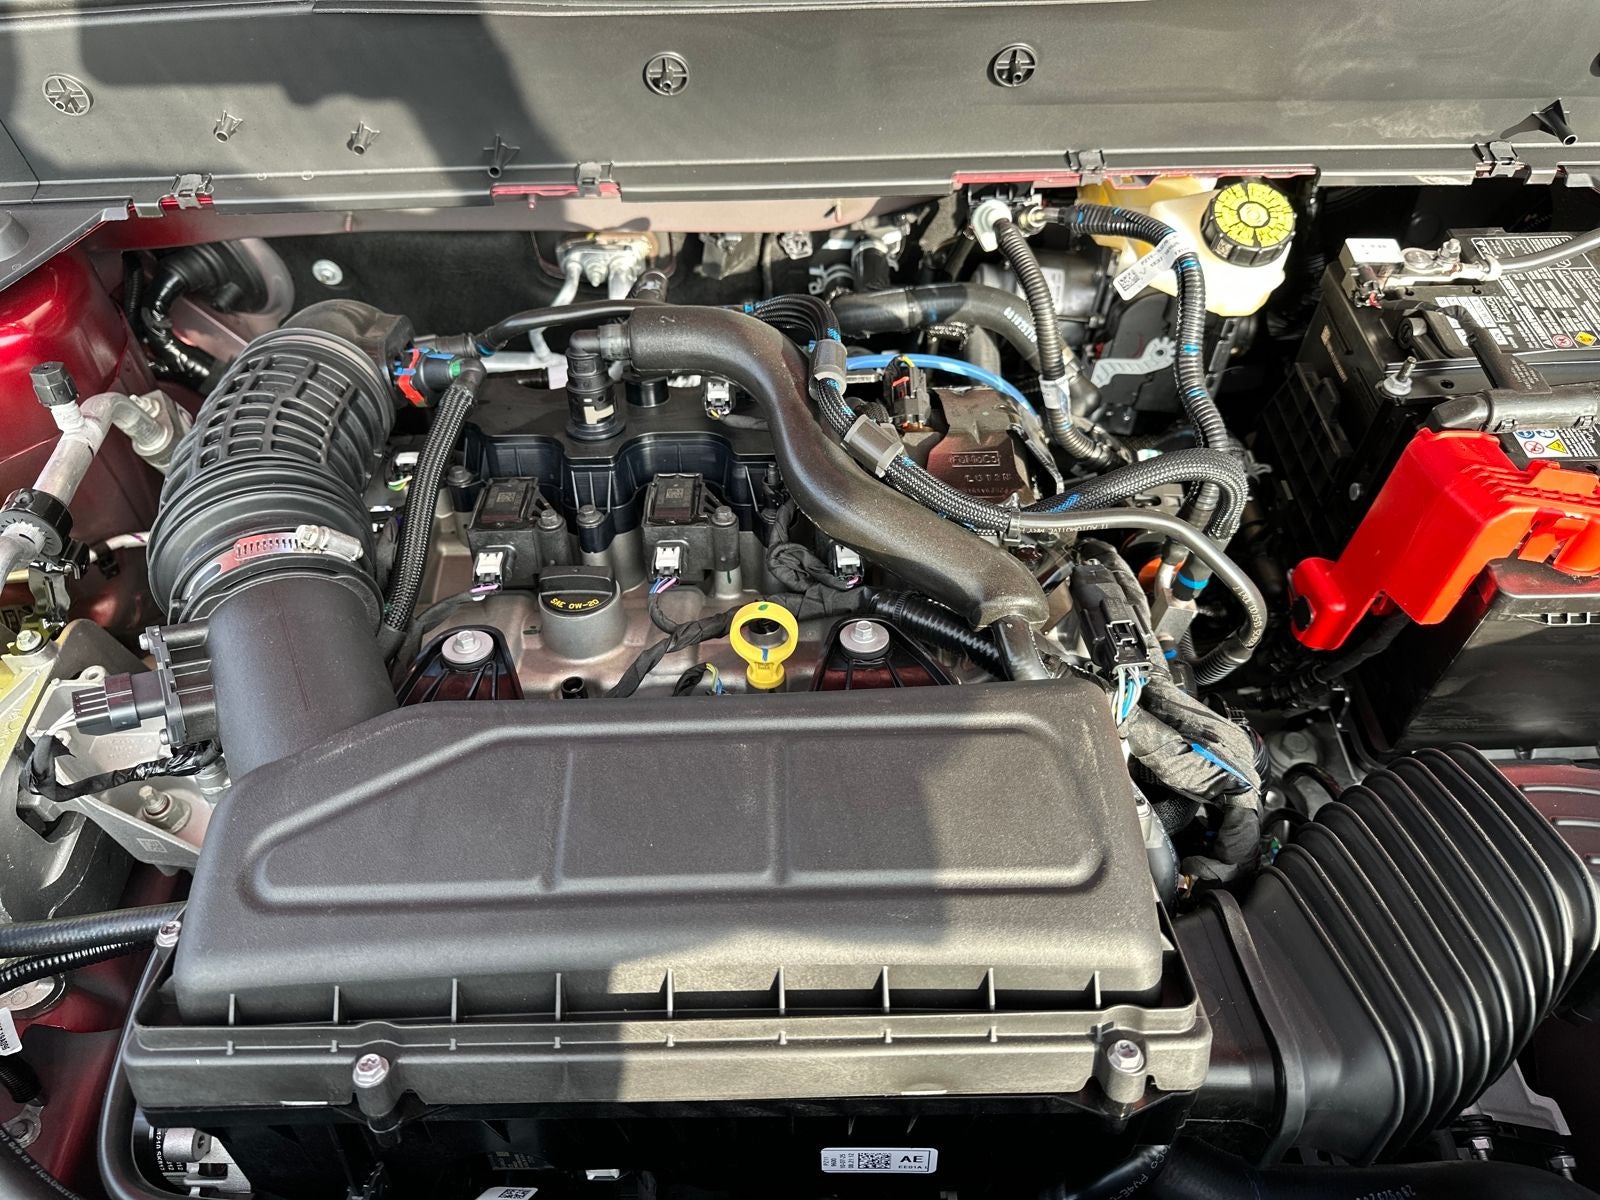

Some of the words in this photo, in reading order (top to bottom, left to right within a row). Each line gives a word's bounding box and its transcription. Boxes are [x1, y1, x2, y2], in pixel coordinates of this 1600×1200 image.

[550, 597, 567, 609] SAE
[568, 598, 600, 610] 0W-20
[899, 1155, 924, 1163] AE
